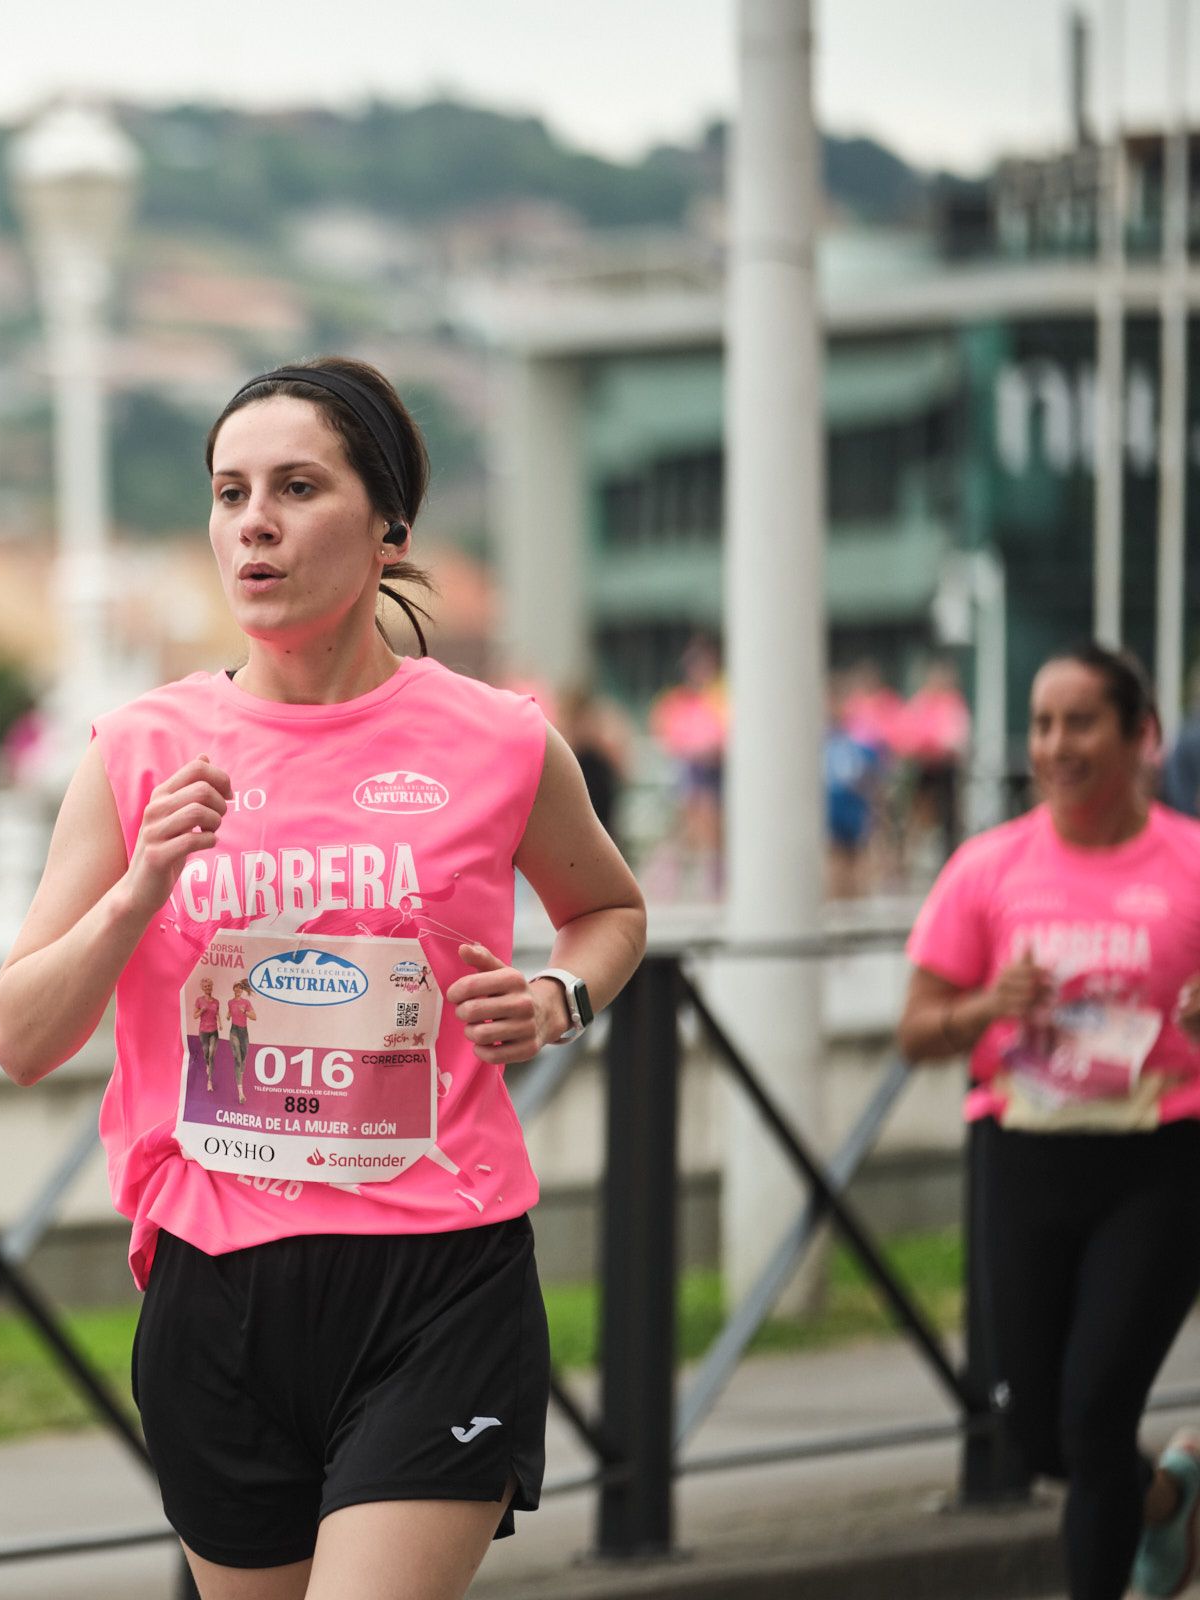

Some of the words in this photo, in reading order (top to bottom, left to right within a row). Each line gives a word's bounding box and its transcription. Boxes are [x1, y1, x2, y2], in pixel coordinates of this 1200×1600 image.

[360, 786, 442, 804] ASTURIANA
[180, 843, 422, 923] CARRERA
[211, 942, 246, 954] DORSAL
[200, 952, 245, 969] SUMA
[277, 966, 315, 975] CENTRAL
[258, 967, 359, 994] ASTURIANA
[254, 1047, 355, 1089] 016
[361, 1054, 427, 1065] CORREDORA
[284, 1096, 320, 1114] 889
[216, 1109, 262, 1128] CARRERA
[265, 1117, 281, 1131] DE
[285, 1119, 301, 1132] LA
[305, 1121, 349, 1134] MUJER
[361, 1119, 397, 1135] GIJÓN
[204, 1137, 275, 1163] OYSHO
[328, 1153, 406, 1168] Santander
